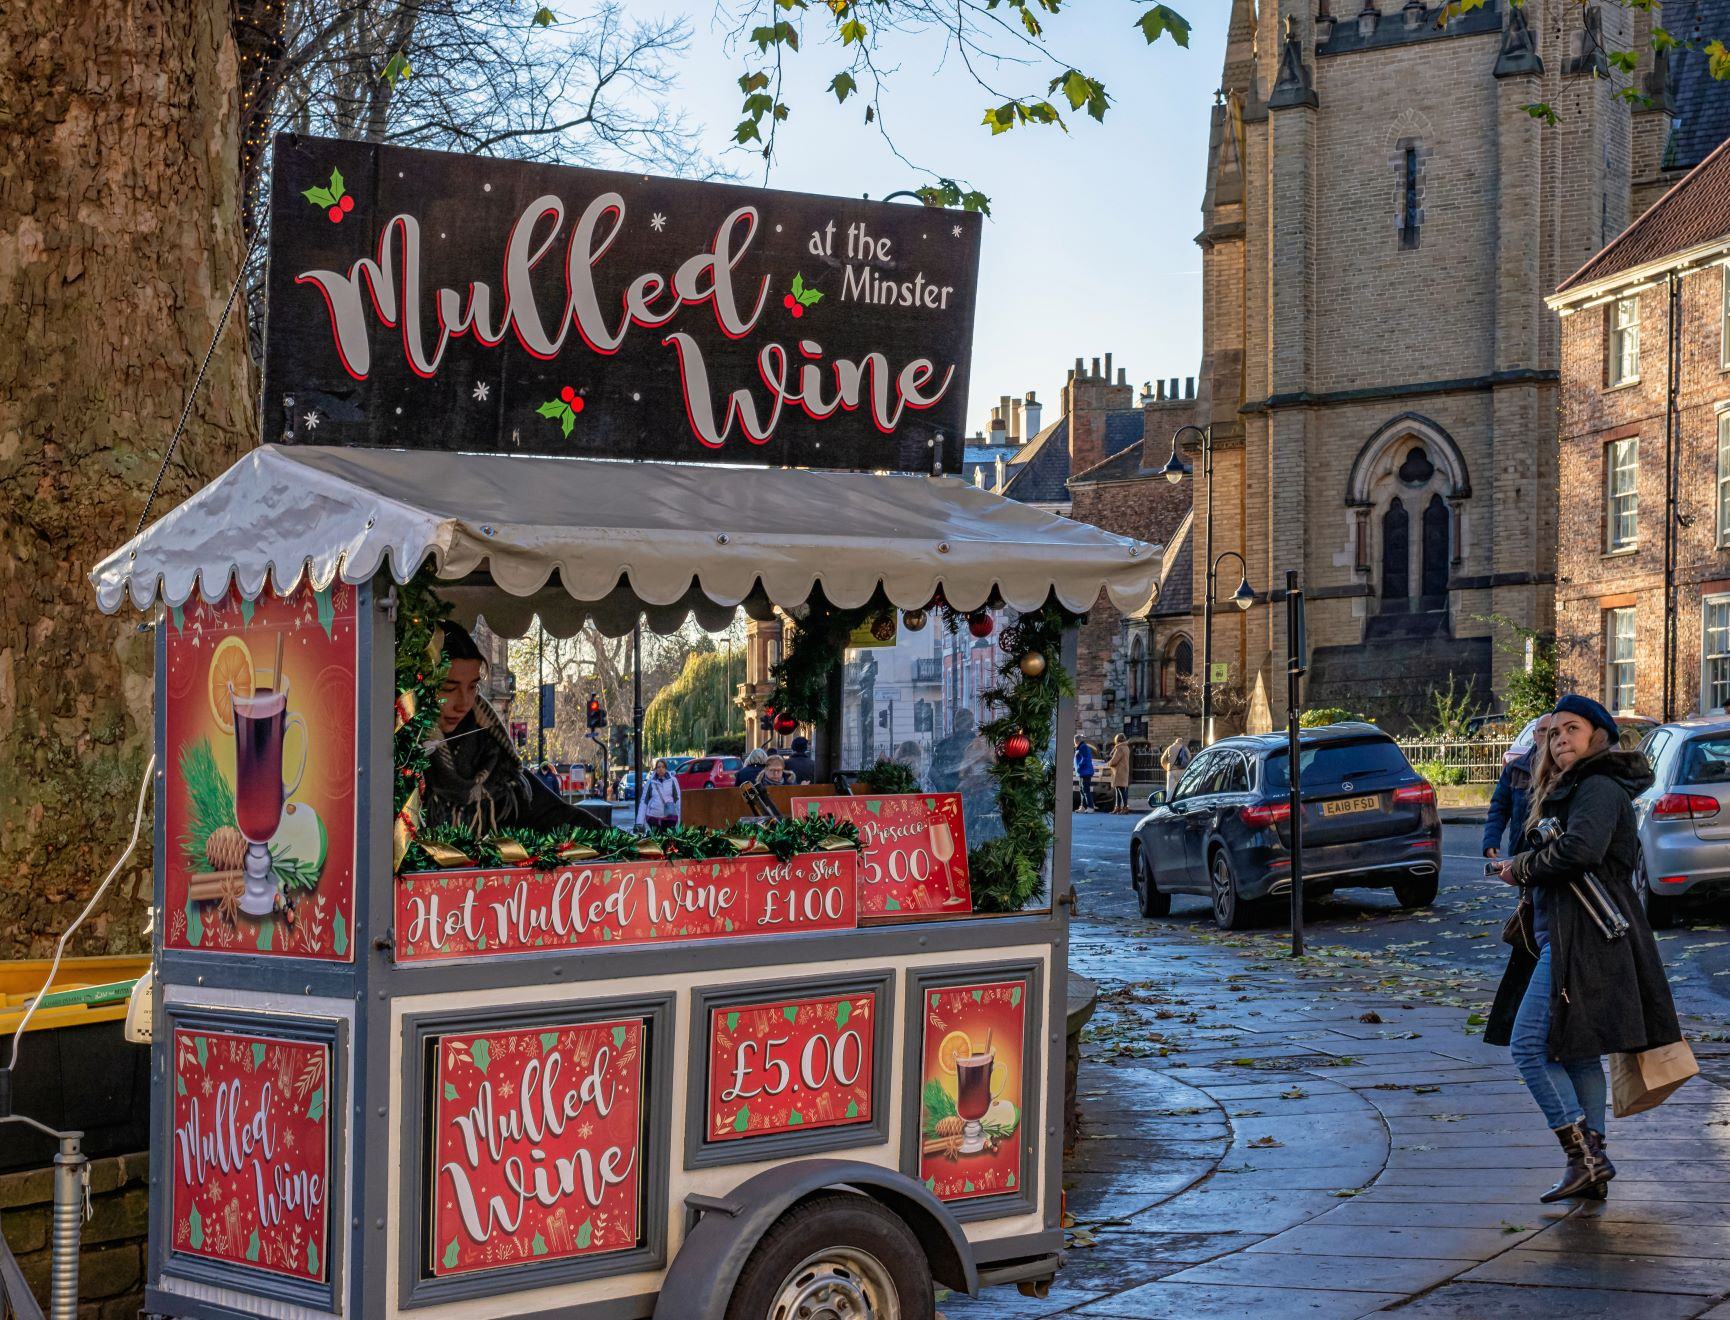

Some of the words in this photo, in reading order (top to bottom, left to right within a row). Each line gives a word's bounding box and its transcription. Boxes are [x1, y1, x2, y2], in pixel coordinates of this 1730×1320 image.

[808, 219, 837, 257] at
[847, 222, 892, 261] the
[294, 192, 771, 381] Mulled
[840, 264, 954, 310] Minster
[661, 332, 955, 450] Wine
[862, 820, 926, 846] Prosecco
[1326, 801, 1351, 814] EA18
[1353, 797, 1375, 811] FSD
[756, 862, 794, 886] Add
[795, 869, 806, 879] a
[808, 858, 842, 883] Shot
[757, 886, 844, 925] £1.00
[405, 888, 486, 950] Hot
[488, 870, 636, 945] Mulled
[643, 876, 738, 926] Wine
[720, 1029, 864, 1103] £5.00
[175, 1077, 276, 1186] Mulled
[452, 1046, 616, 1167] Mulled
[252, 1158, 325, 1229] Wine
[441, 1144, 636, 1243] Wine
